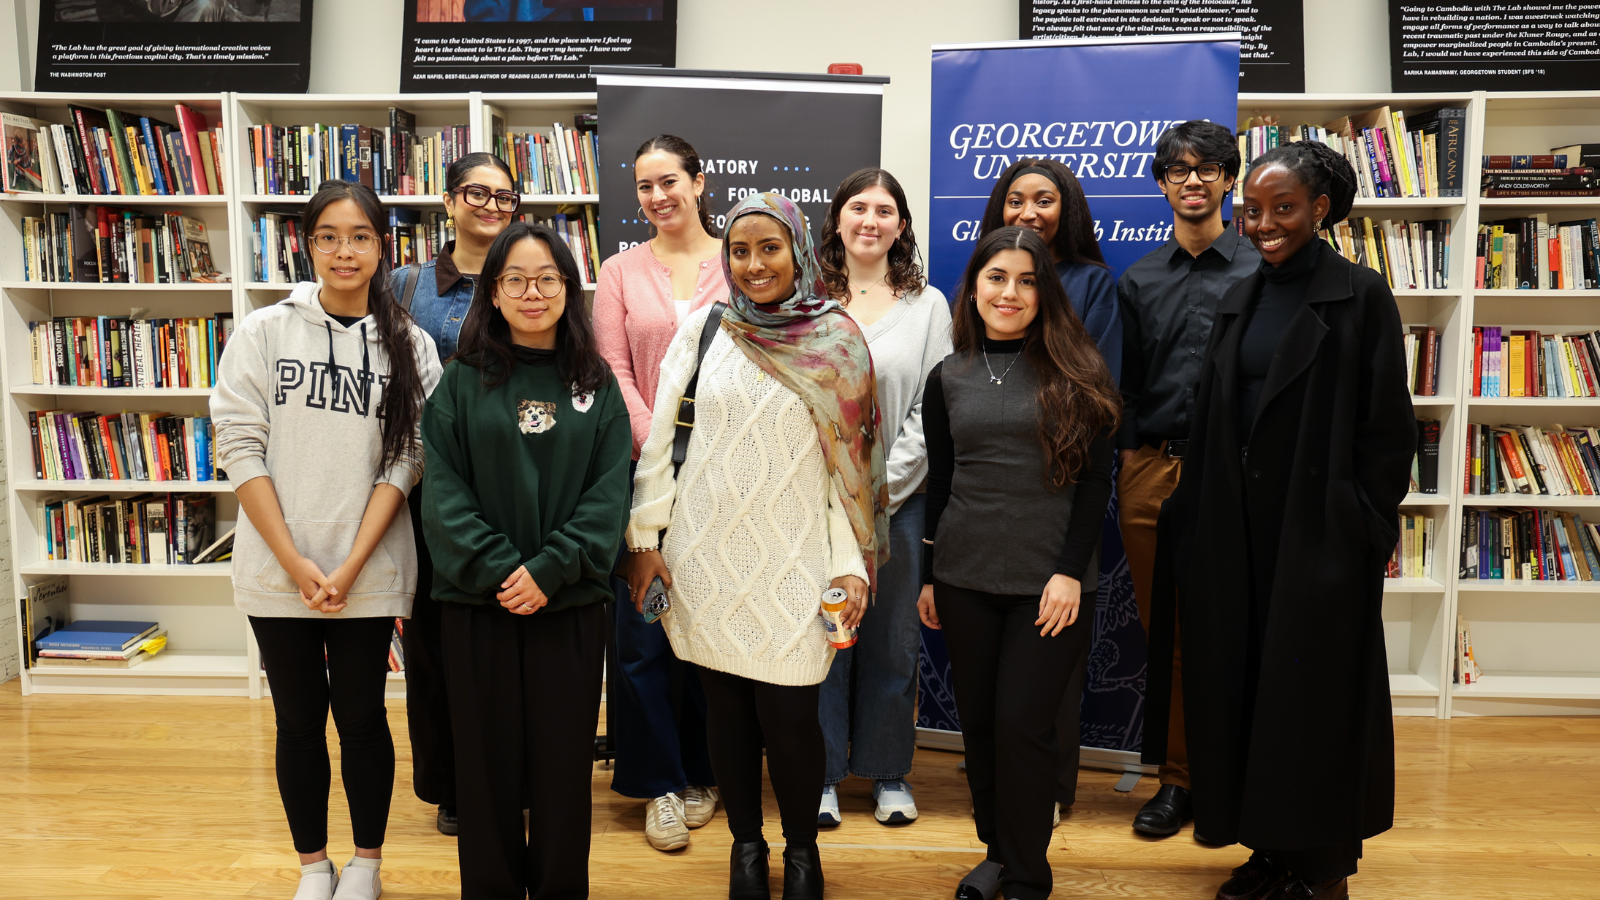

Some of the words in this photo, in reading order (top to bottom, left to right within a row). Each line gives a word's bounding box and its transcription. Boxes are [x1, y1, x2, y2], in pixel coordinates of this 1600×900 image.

[1032, 6, 1056, 14] legacy
[559, 36, 579, 44] place
[949, 120, 1188, 160] GEORGETOW
[1447, 125, 1459, 180] AFRICANA
[699, 159, 758, 175] RATORY
[1108, 220, 1174, 242] Instit
[120, 330, 128, 354] DIRECTOR'S
[133, 318, 142, 351] THEATER
[55, 343, 63, 367] DOCTORS
[135, 354, 144, 375] IDEAL
[137, 377, 144, 387] AN
[1577, 521, 1590, 550] PRESENT
[1588, 552, 1596, 568] PAST
